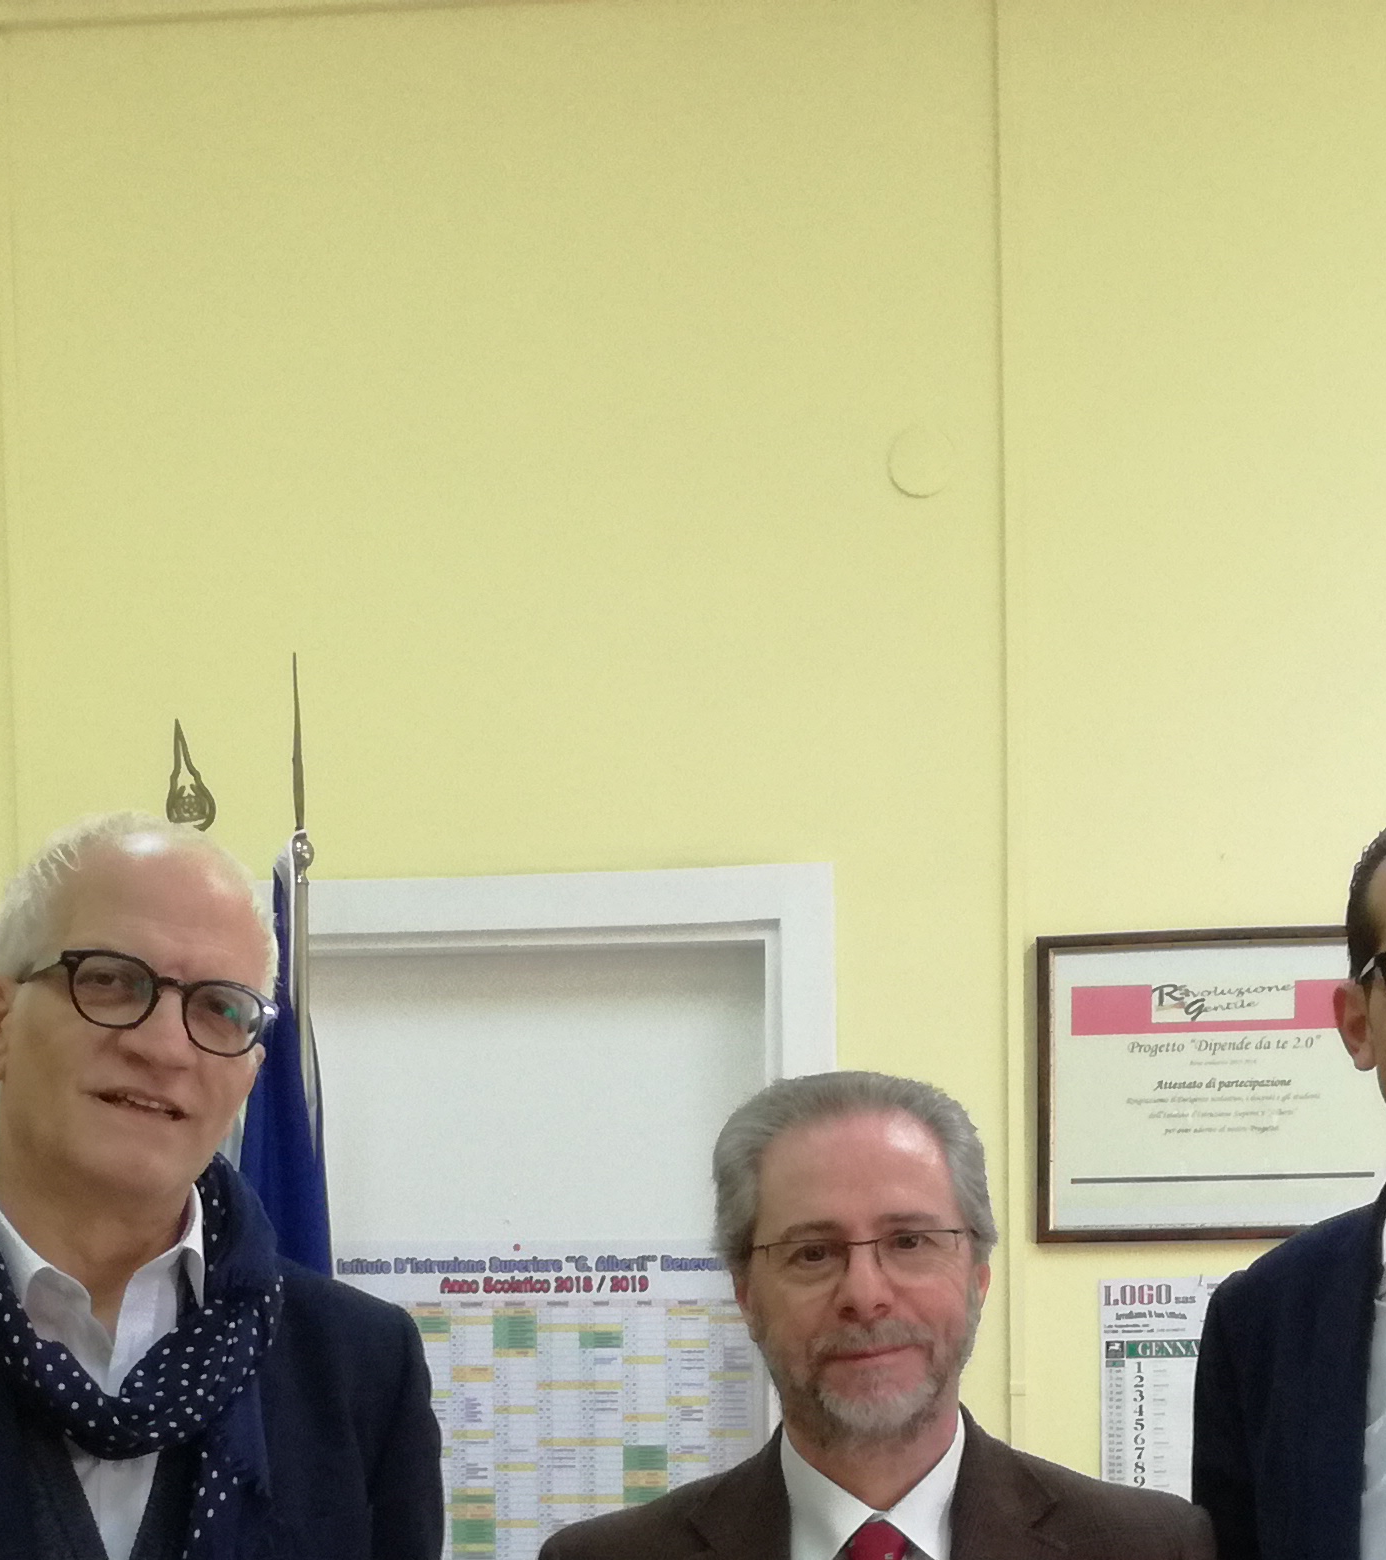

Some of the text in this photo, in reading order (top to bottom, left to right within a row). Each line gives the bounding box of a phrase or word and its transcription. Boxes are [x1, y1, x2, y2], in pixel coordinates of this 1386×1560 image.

[1184, 998, 1259, 1021] Gentile
[1128, 1041, 1185, 1057] Progetto
[1254, 1036, 1271, 1049] da
[1275, 1039, 1288, 1049] te
[1153, 1077, 1292, 1091] Attestato di partecipazione
[336, 1258, 392, 1275] Istituto
[394, 1256, 486, 1274] D'Istruzione
[488, 1256, 563, 1273] Superiore
[439, 1276, 479, 1294] Anno
[554, 1275, 593, 1293] 2018
[610, 1275, 649, 1292] 2019
[1104, 1284, 1172, 1306] LOGO
[1136, 1362, 1144, 1373] 1
[1134, 1375, 1144, 1387] 2
[1133, 1389, 1144, 1402] 3
[1134, 1404, 1144, 1416] 4
[1134, 1418, 1144, 1430] 5
[1134, 1433, 1145, 1445] 6
[1134, 1447, 1145, 1459] 7
[1134, 1461, 1145, 1474] 8
